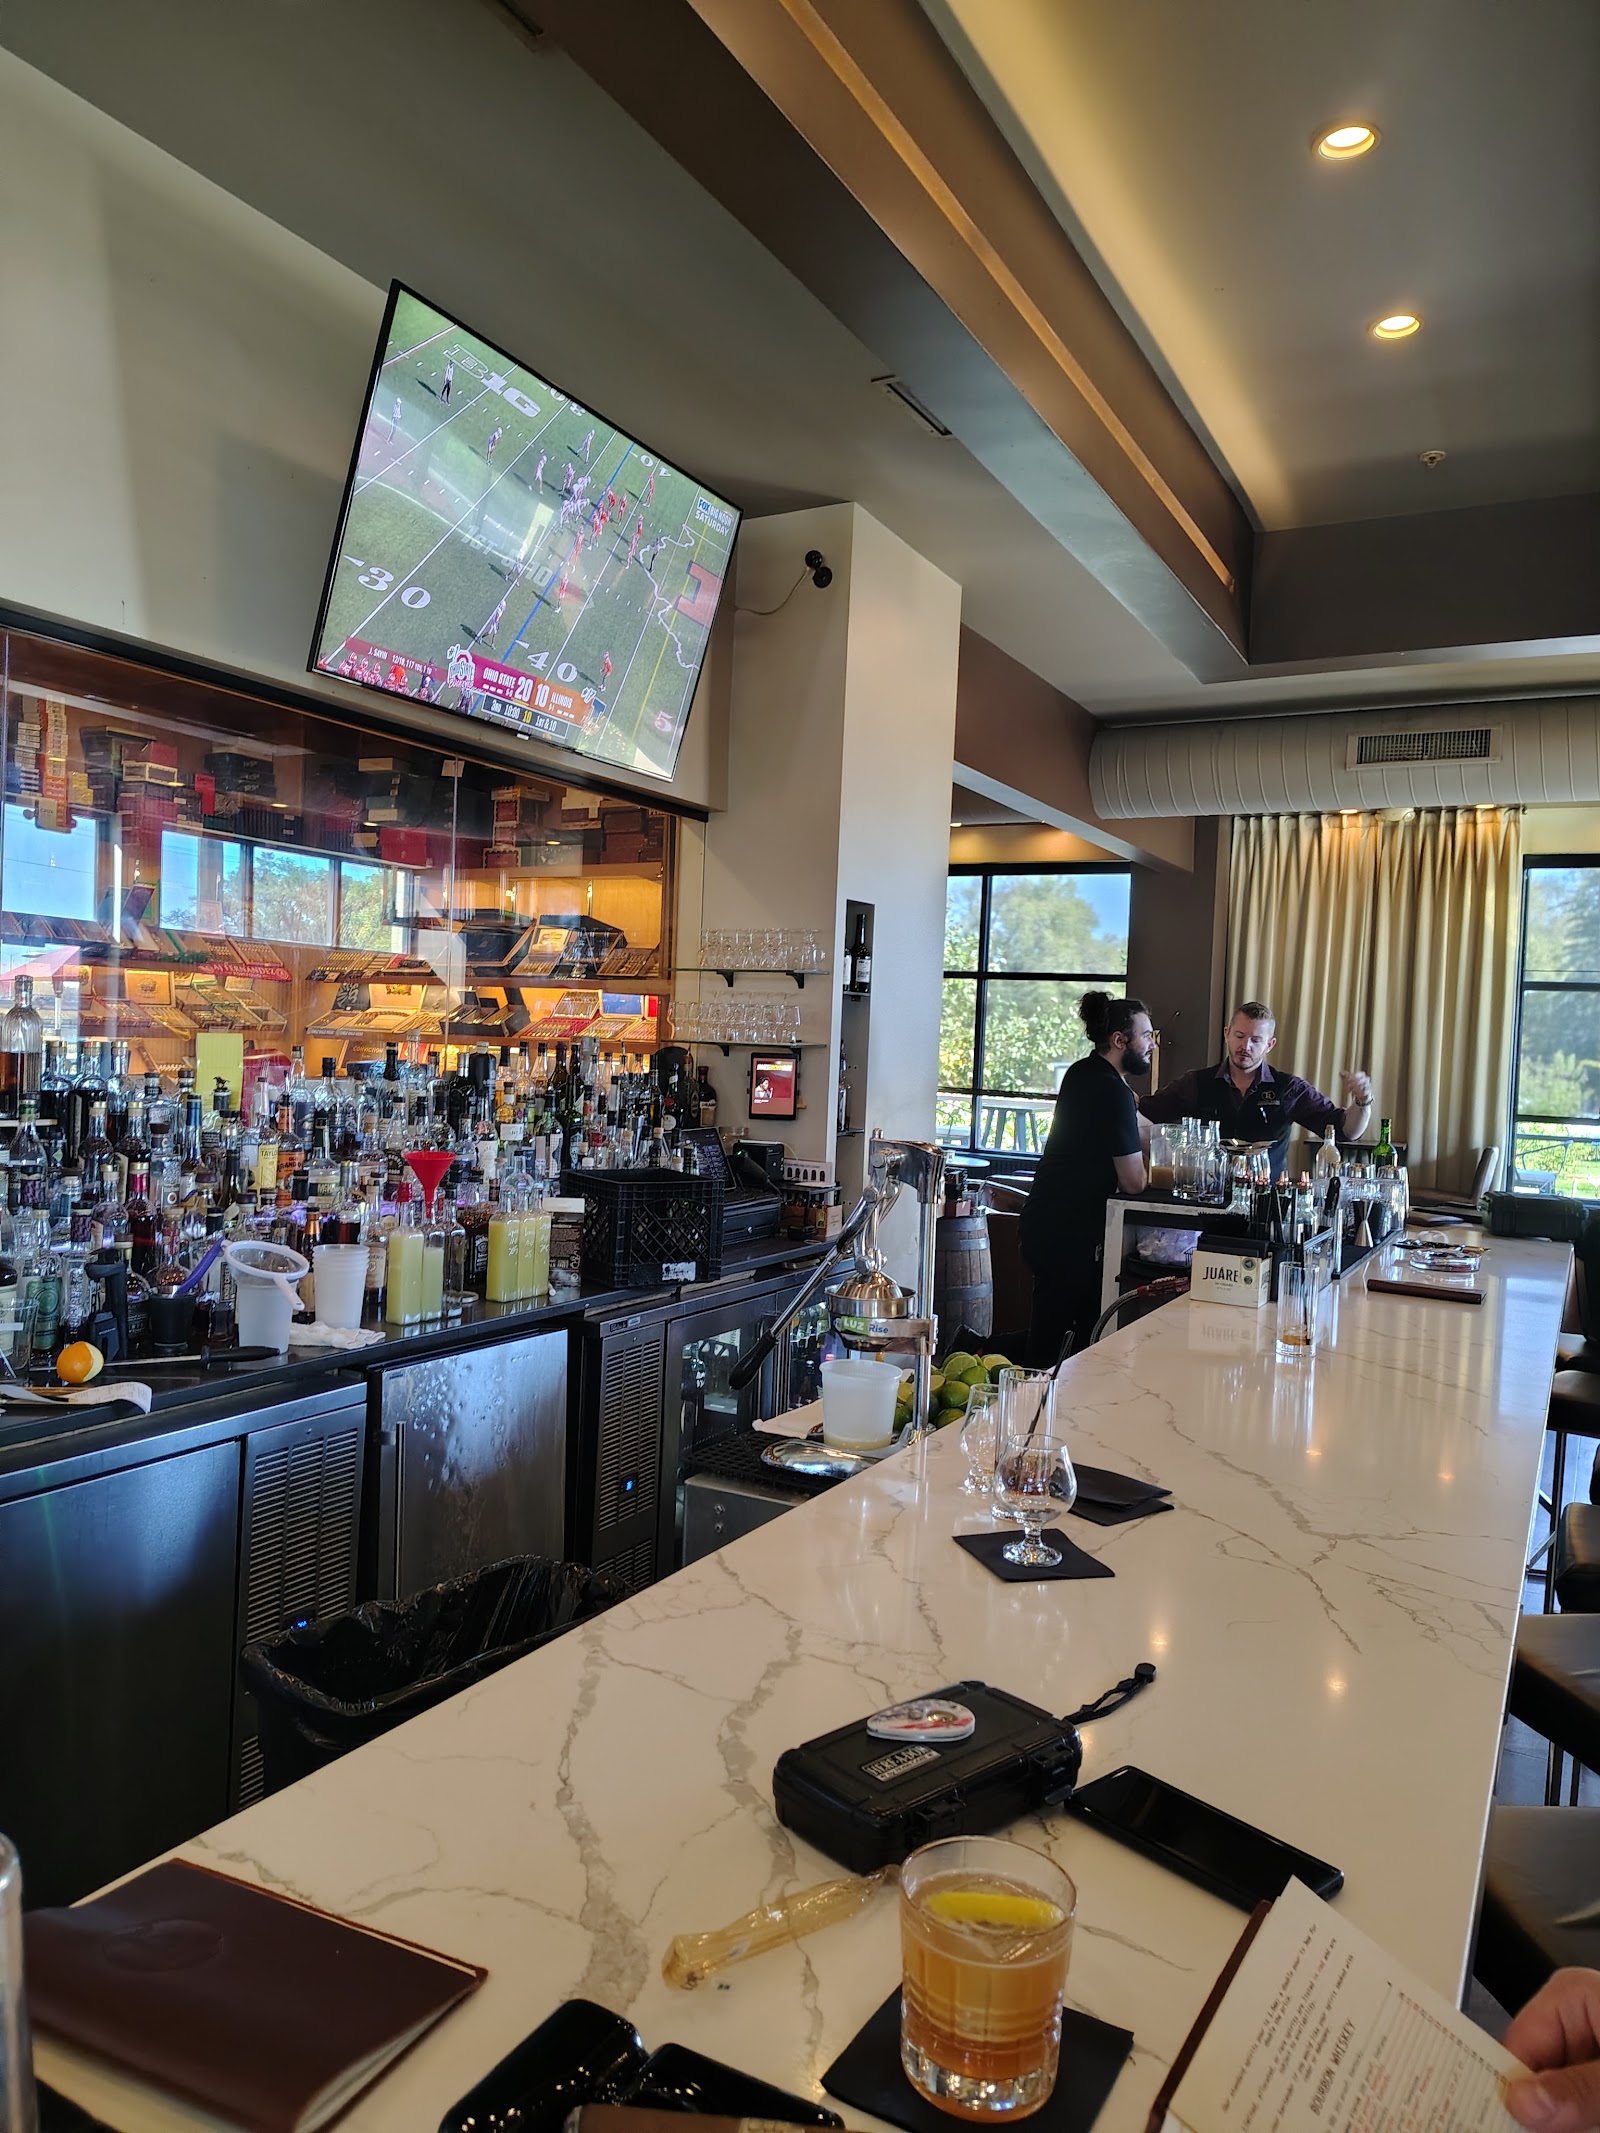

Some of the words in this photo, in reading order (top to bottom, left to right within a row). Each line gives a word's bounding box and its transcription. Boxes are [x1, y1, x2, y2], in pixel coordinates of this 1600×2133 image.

[698, 499, 711, 513] FOX
[695, 510, 730, 536] SATURDAY
[483, 667, 498, 682] OHIO
[498, 672, 517, 689] STATE
[514, 676, 534, 703] 20
[535, 683, 550, 708] 10
[551, 692, 573, 709] ILLINOIS
[353, 1046, 384, 1054] CONVICTION
[868, 1323, 889, 1334] Rise
[1309, 2066, 1336, 2115] BOURBON
[1330, 2018, 1356, 2066] WHISKEY
